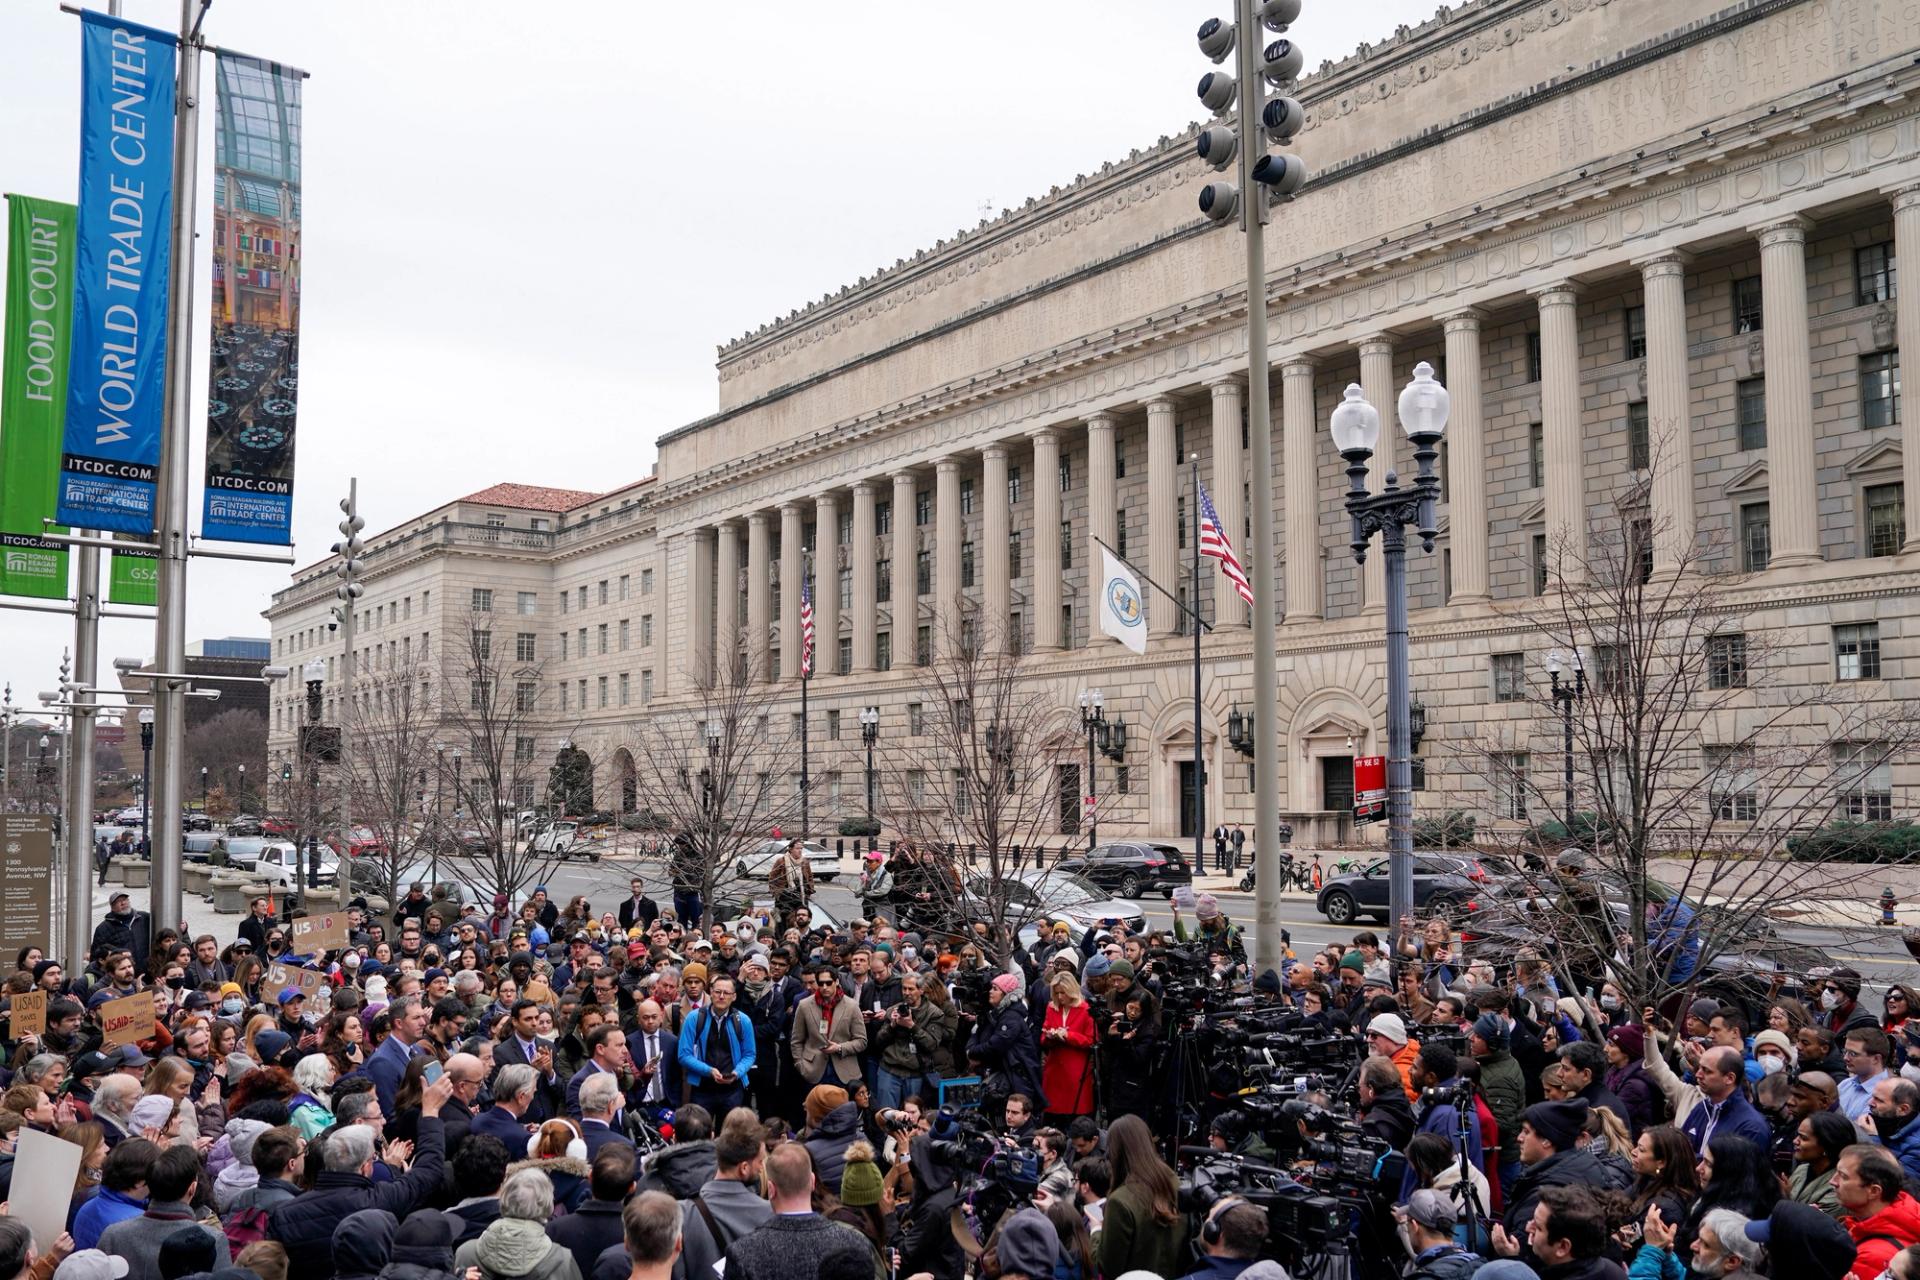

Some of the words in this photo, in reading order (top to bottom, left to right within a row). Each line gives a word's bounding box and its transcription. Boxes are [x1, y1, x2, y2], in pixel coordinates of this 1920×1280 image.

[1511, 108, 1588, 148] FOSTERS
[1600, 57, 1725, 116] INDIVIDUAL
[1735, 8, 1858, 67] INITIATIVE
[110, 28, 146, 166] CENTER
[1358, 136, 1470, 190] GOVERNMENT
[1508, 88, 1600, 134] CONSENT
[1644, 56, 1684, 84] THE
[1696, 2, 1824, 64] GOVERNED
[1472, 139, 1548, 178] LIGHTEN
[1558, 102, 1650, 148] BURDENS
[1662, 61, 1762, 111] WITHOUT
[1776, 4, 1918, 70] LESSENING
[1464, 128, 1624, 197] ADMINISTRATION
[1634, 101, 1698, 137] GIVEN
[1708, 88, 1736, 111] TO
[1748, 68, 1792, 97] THE
[106, 174, 144, 291] TRADE
[30, 212, 58, 311] COURT
[26, 320, 56, 402] FOOD
[96, 304, 138, 445] WORLD
[68, 458, 152, 480] ITCDC.COM
[68, 478, 90, 486] RONALD
[212, 476, 288, 493] ITCDC.COM
[85, 486, 150, 501] INTERNATIONAL
[86, 494, 114, 504] TRADE
[116, 498, 149, 511] CENTER
[227, 501, 286, 514] INTERNATIONAL
[227, 510, 254, 519] TRADE
[255, 513, 286, 522] CENTER
[4, 536, 61, 548] ITCDC.com
[28, 554, 57, 562] RONALD
[28, 560, 56, 568] REAGAN
[294, 916, 333, 936] USAID
[14, 995, 42, 1011] USAID
[20, 1013, 36, 1022] SAVES
